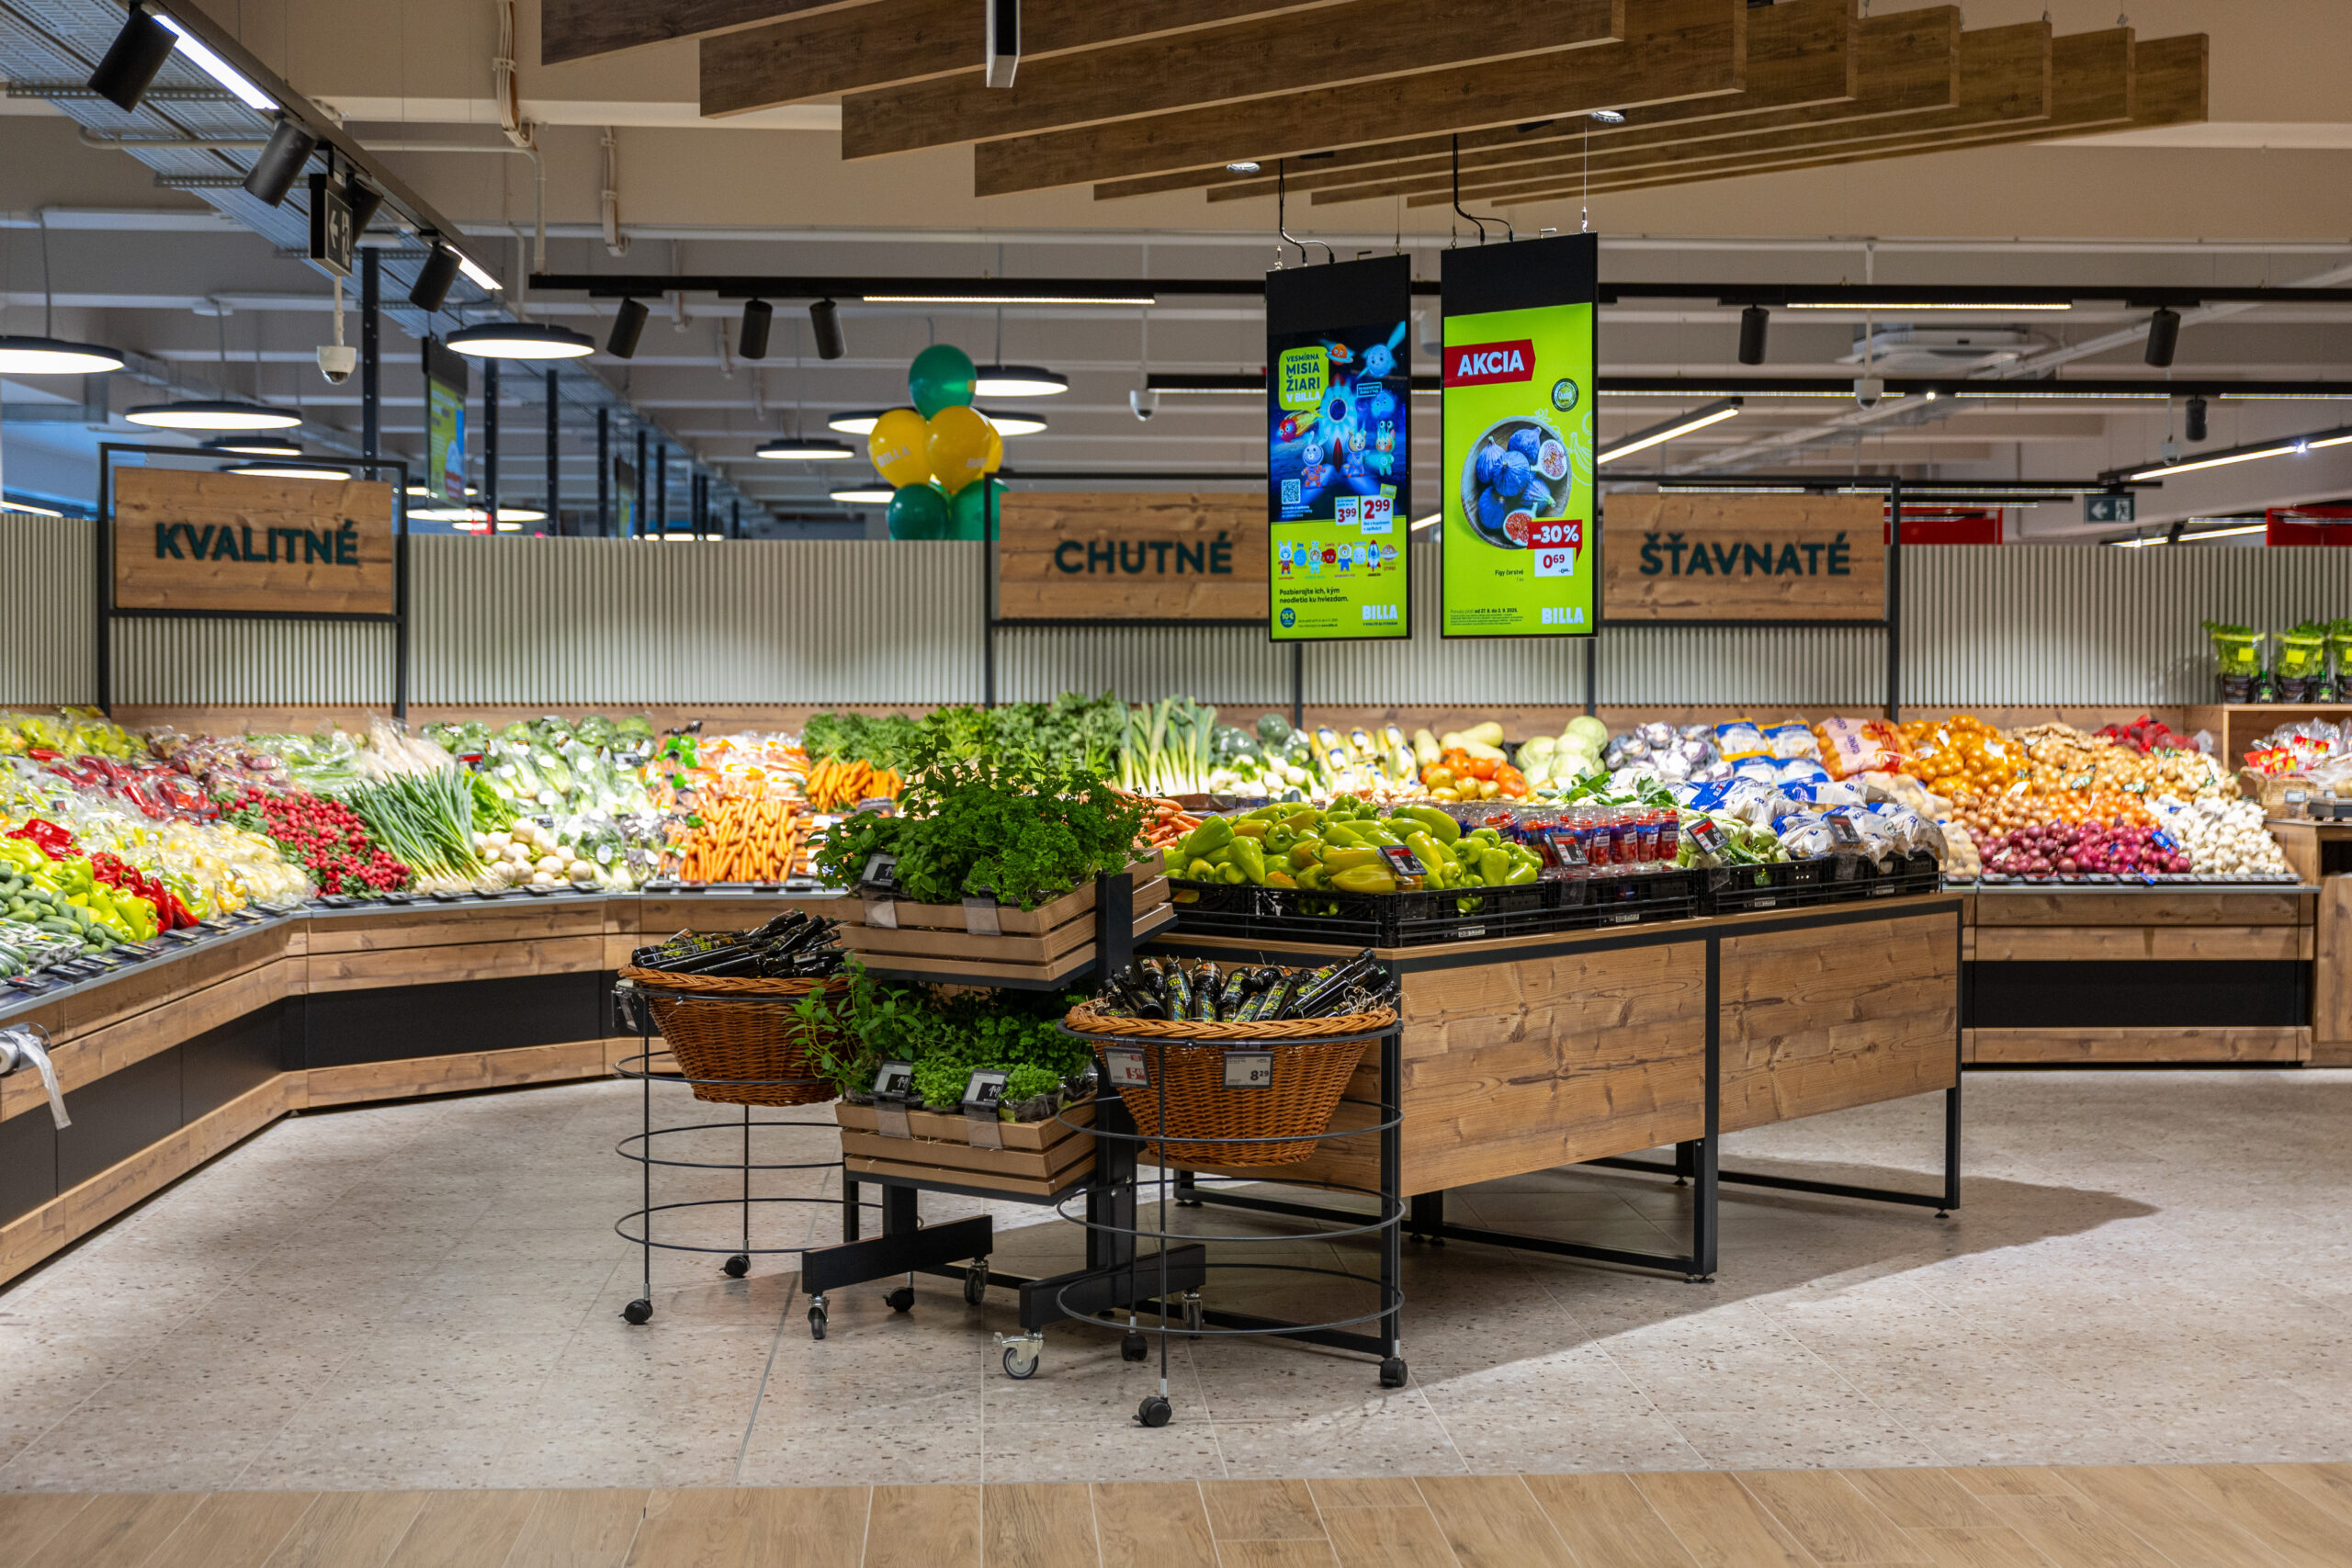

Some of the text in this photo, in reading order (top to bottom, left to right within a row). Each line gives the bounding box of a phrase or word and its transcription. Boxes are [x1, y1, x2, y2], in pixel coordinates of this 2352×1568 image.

[1286, 353, 1319, 363] VESMÍRNA
[1457, 350, 1525, 377] AKCIA
[1286, 361, 1320, 376] MISIA
[1286, 375, 1320, 392] ŽIARI
[1286, 390, 1321, 403] V BILLA
[876, 445, 911, 468] BILLA
[156, 519, 358, 565] KVALITNÉ
[1532, 525, 1579, 544] -30%
[1054, 530, 1233, 574] CHUTNÉ
[1639, 530, 1850, 575] ŠŤAVNATÉ
[1279, 588, 1314, 596] Pozbierajte
[1362, 604, 1398, 620] BILLA
[1542, 606, 1585, 624] BILLA
